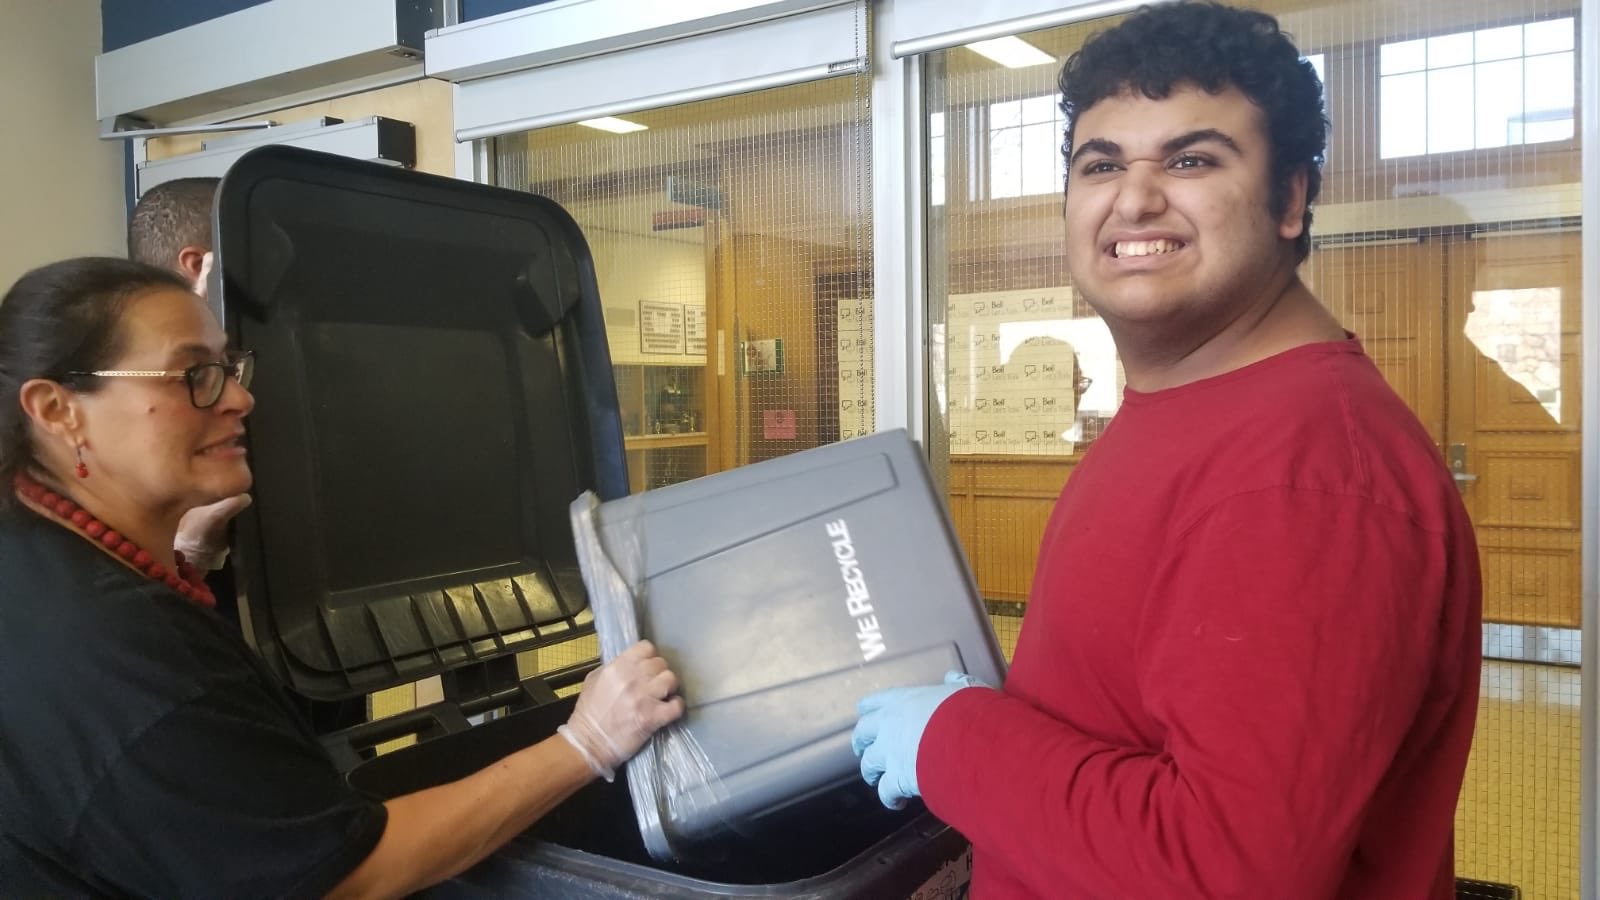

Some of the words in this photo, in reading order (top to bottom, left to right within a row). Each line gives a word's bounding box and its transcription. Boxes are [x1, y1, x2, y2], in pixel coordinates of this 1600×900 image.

[991, 366, 1004, 375] Bell
[992, 398, 1006, 407] Bell
[993, 430, 1006, 439] Bell
[825, 517, 874, 617] RECYCLE
[856, 614, 887, 662] WE
